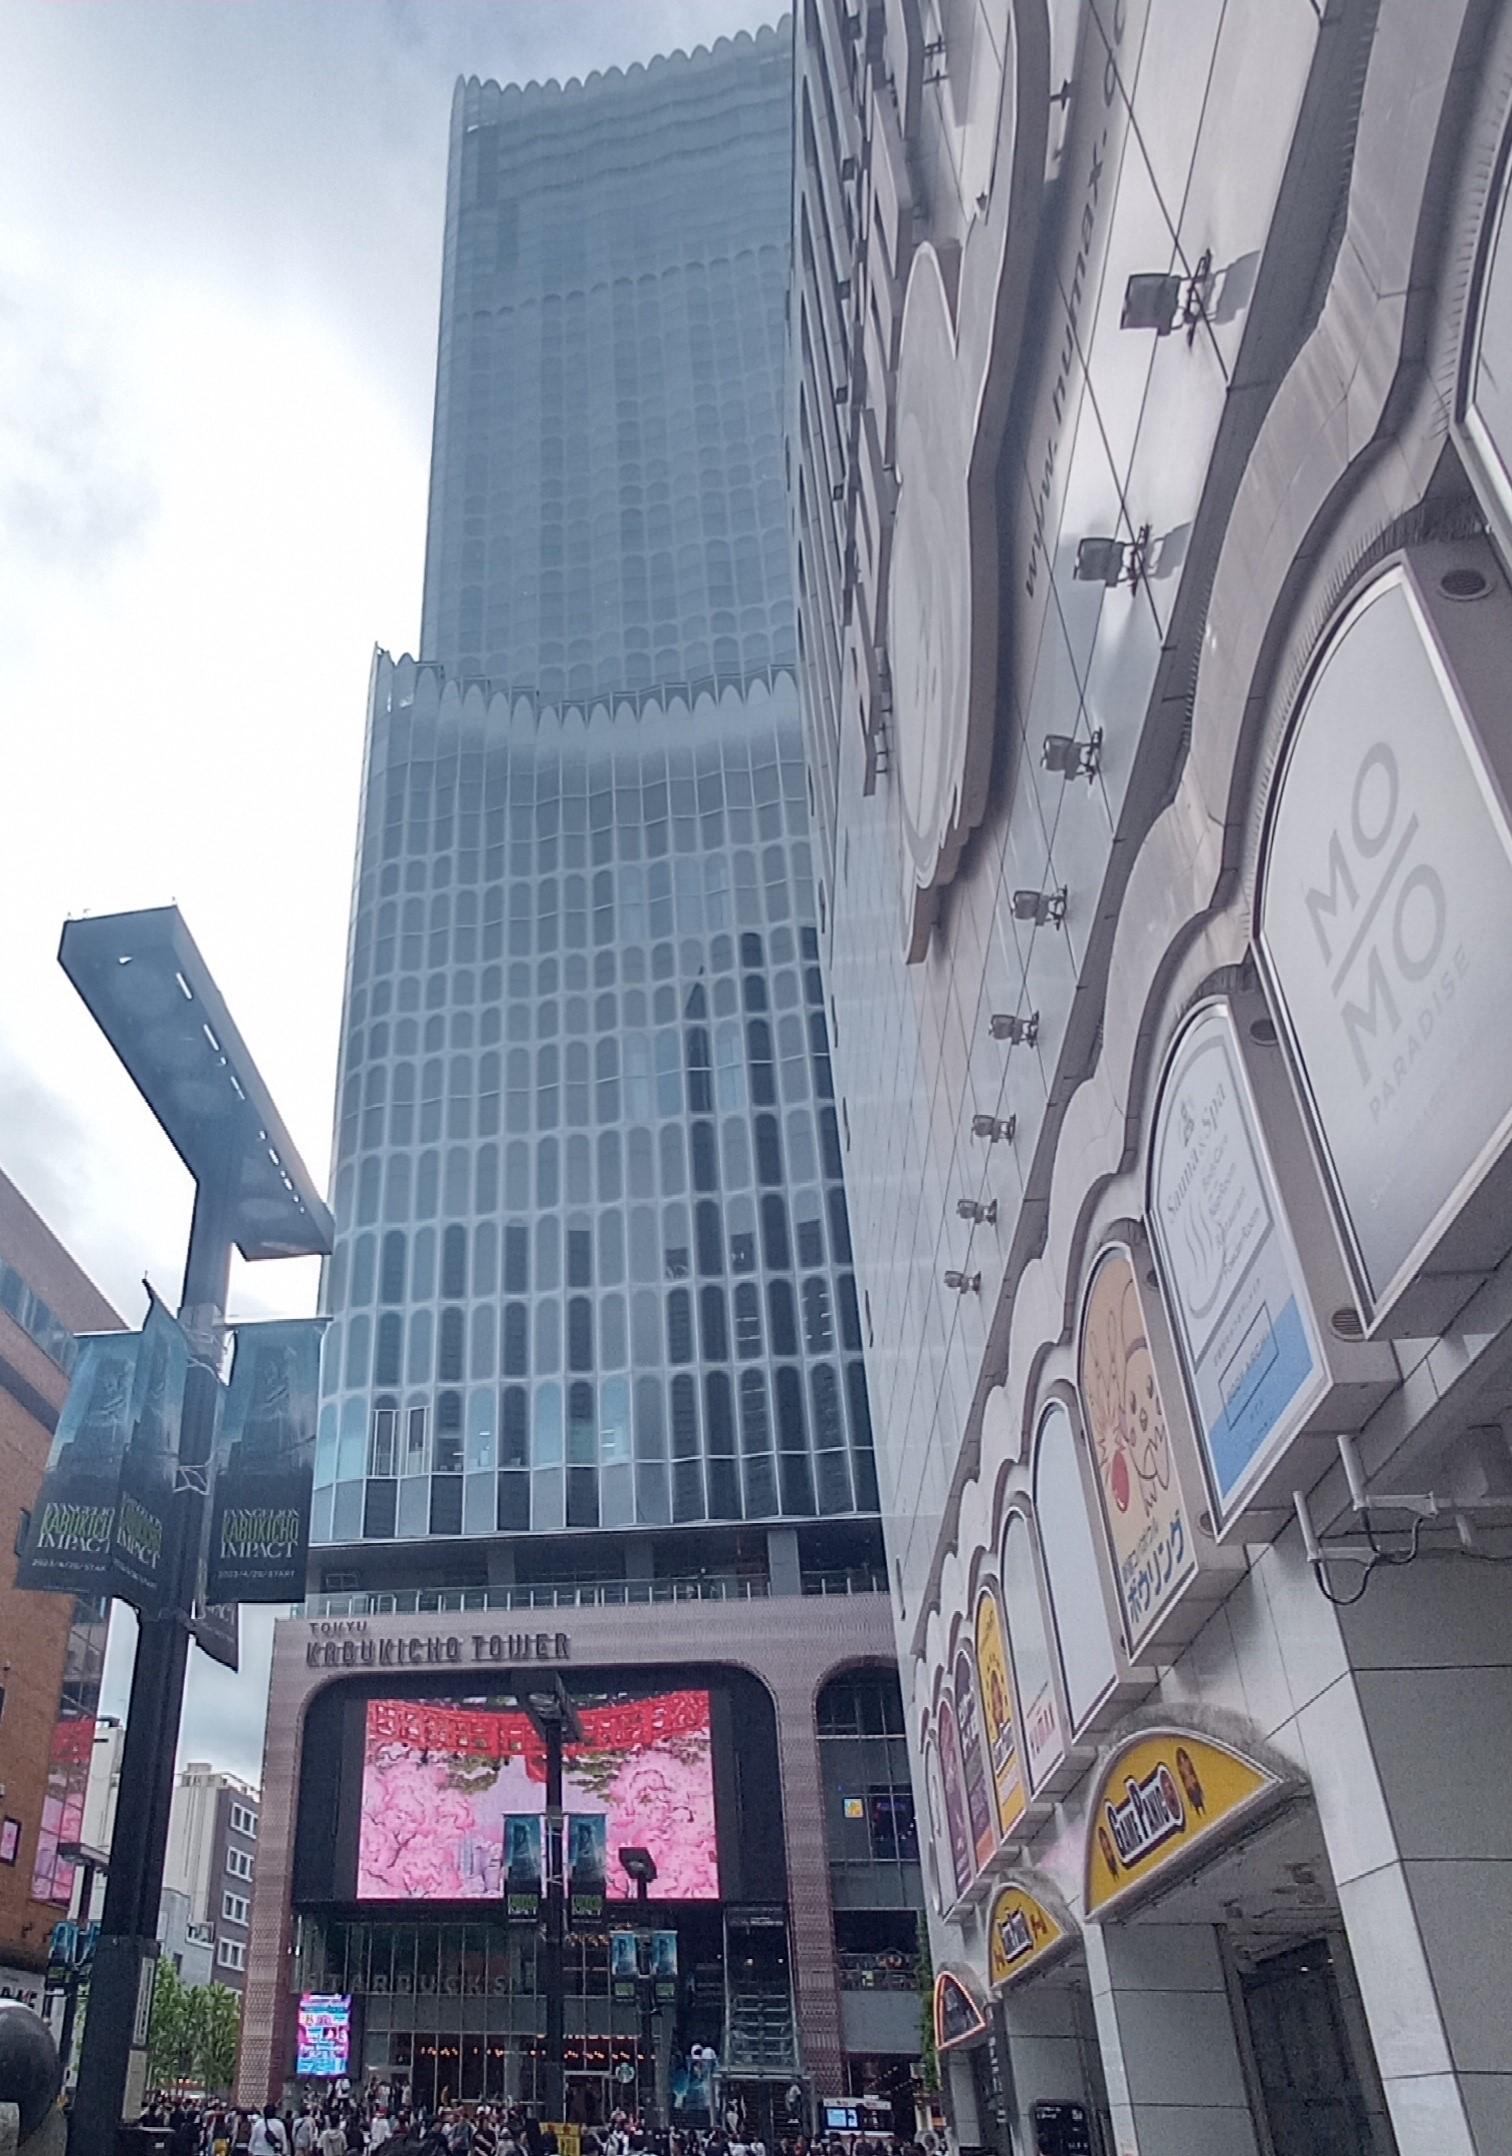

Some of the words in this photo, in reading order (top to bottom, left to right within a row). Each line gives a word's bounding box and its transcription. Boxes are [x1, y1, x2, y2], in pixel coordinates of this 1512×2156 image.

[1305, 741, 1399, 965] MO
[1342, 863, 1446, 1087] MO
[1369, 944, 1470, 1123] PARADISE
[219, 1541, 298, 1559] IMPACT
[221, 1517, 300, 1544] KABUKICHO
[1127, 1509, 1184, 1623] ボウリング
[306, 1636, 462, 1667] KABUKICHO
[471, 1633, 571, 1660] TOWER
[308, 1621, 368, 1634] TOKYU
